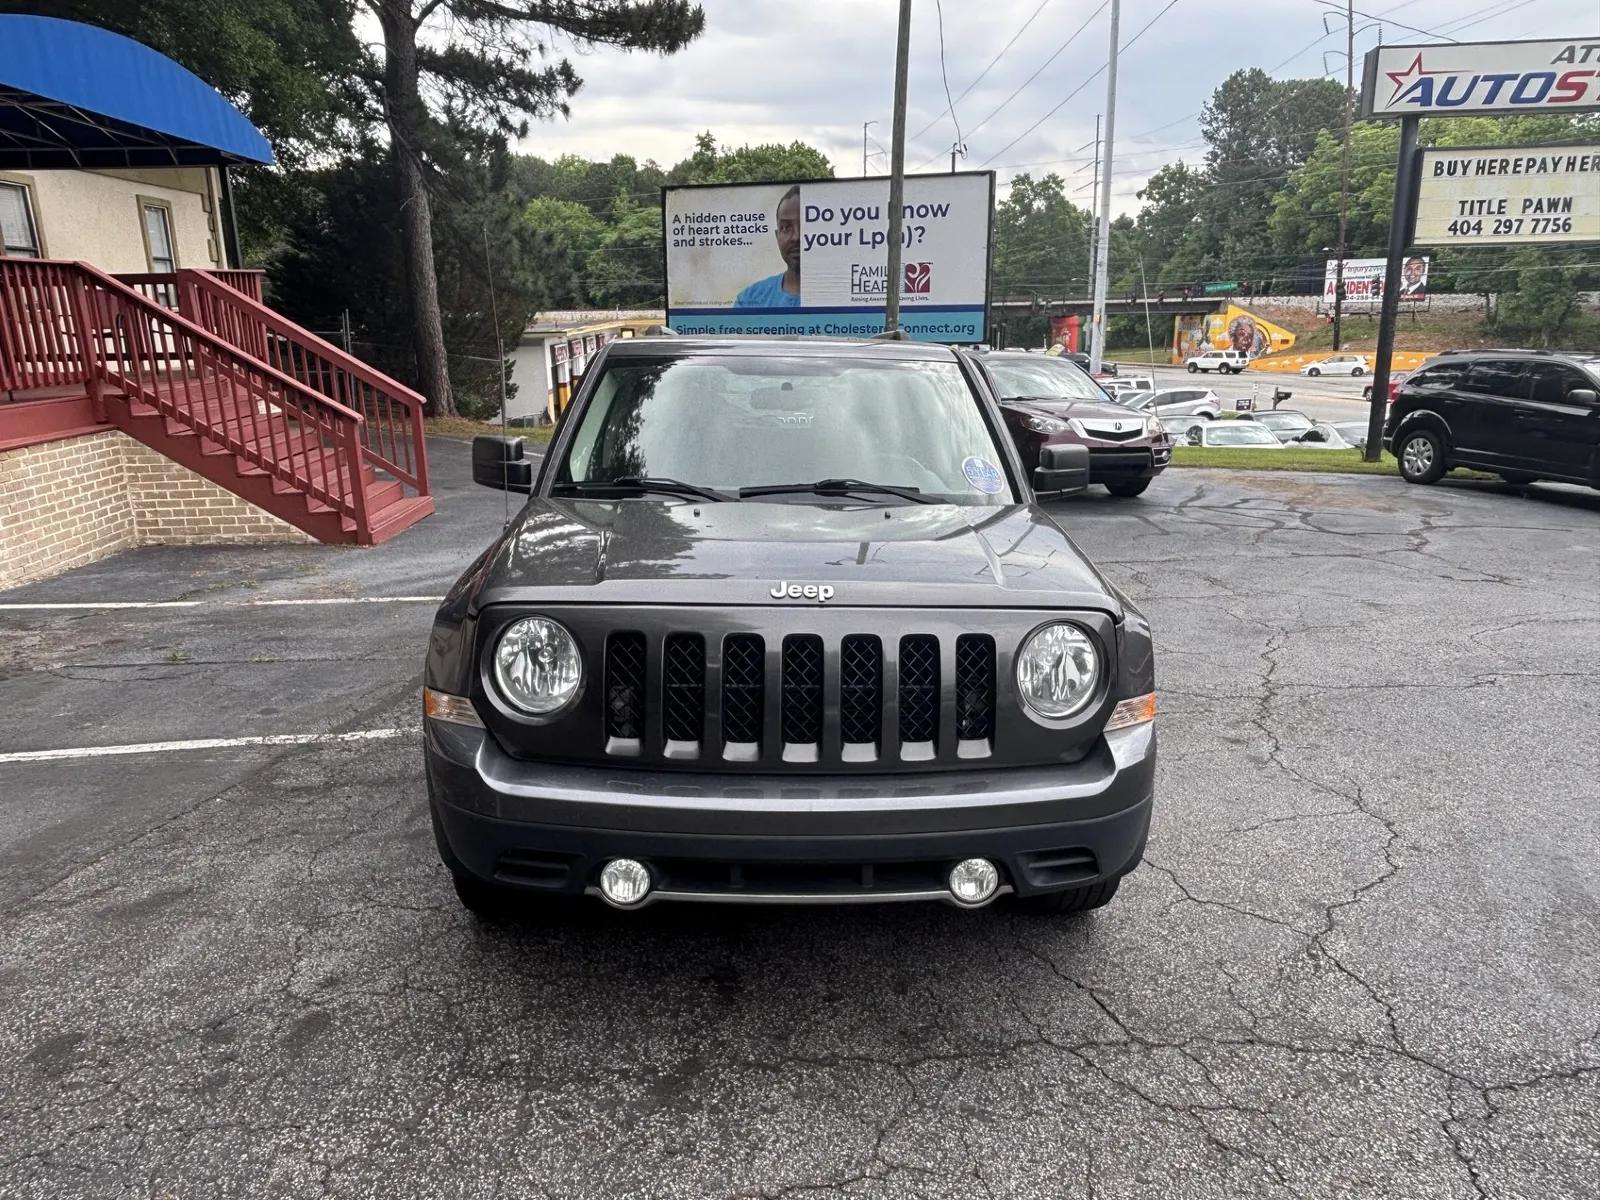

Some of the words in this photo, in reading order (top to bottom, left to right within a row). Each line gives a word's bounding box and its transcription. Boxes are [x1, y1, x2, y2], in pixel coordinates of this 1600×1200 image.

[1550, 44, 1600, 64] AT
[1388, 70, 1600, 109] AUTOS
[804, 205, 835, 223] Do
[840, 206, 880, 226] you
[888, 203, 951, 219] now
[1458, 199, 1507, 216] TITLE
[1521, 197, 1573, 214] PAWN
[672, 214, 681, 224] A
[684, 212, 726, 224] hidden
[729, 212, 766, 222] cause
[1447, 219, 1483, 236] 404
[1492, 218, 1524, 235] 297
[1530, 217, 1573, 234] 7756
[672, 225, 685, 236] of
[688, 224, 721, 236] heart
[723, 222, 769, 235] attacks
[803, 232, 853, 251] your
[859, 225, 926, 250] Lp)?
[673, 236, 696, 248] and
[851, 264, 888, 278] FAMIL
[851, 278, 888, 293] HEAR
[676, 324, 716, 335] Simple
[719, 324, 743, 335] free
[746, 323, 805, 335] screening
[809, 323, 821, 334] at
[770, 580, 834, 602] Jeep
